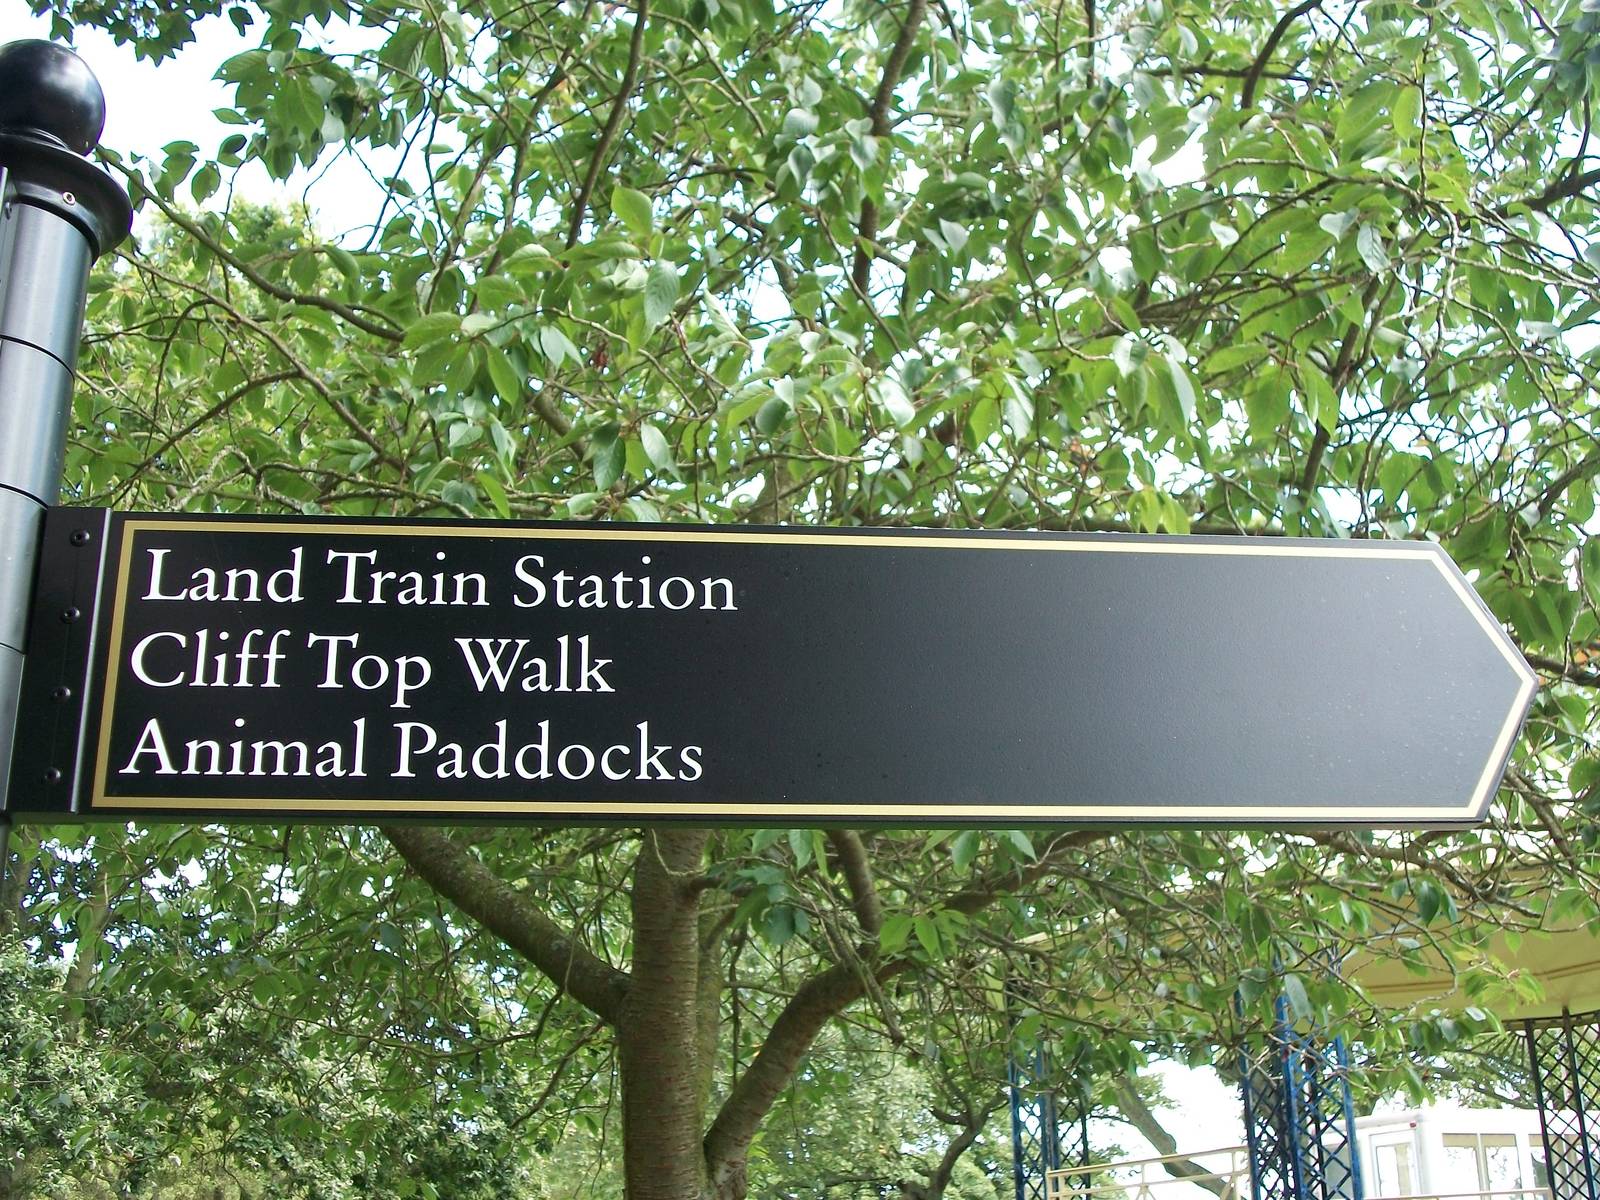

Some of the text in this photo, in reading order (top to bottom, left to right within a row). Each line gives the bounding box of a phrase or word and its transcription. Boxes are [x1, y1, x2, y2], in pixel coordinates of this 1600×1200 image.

[141, 547, 738, 611] Land Train Station
[131, 629, 616, 709] Cliff Top Walk
[118, 718, 703, 782] Animal Paddocks
